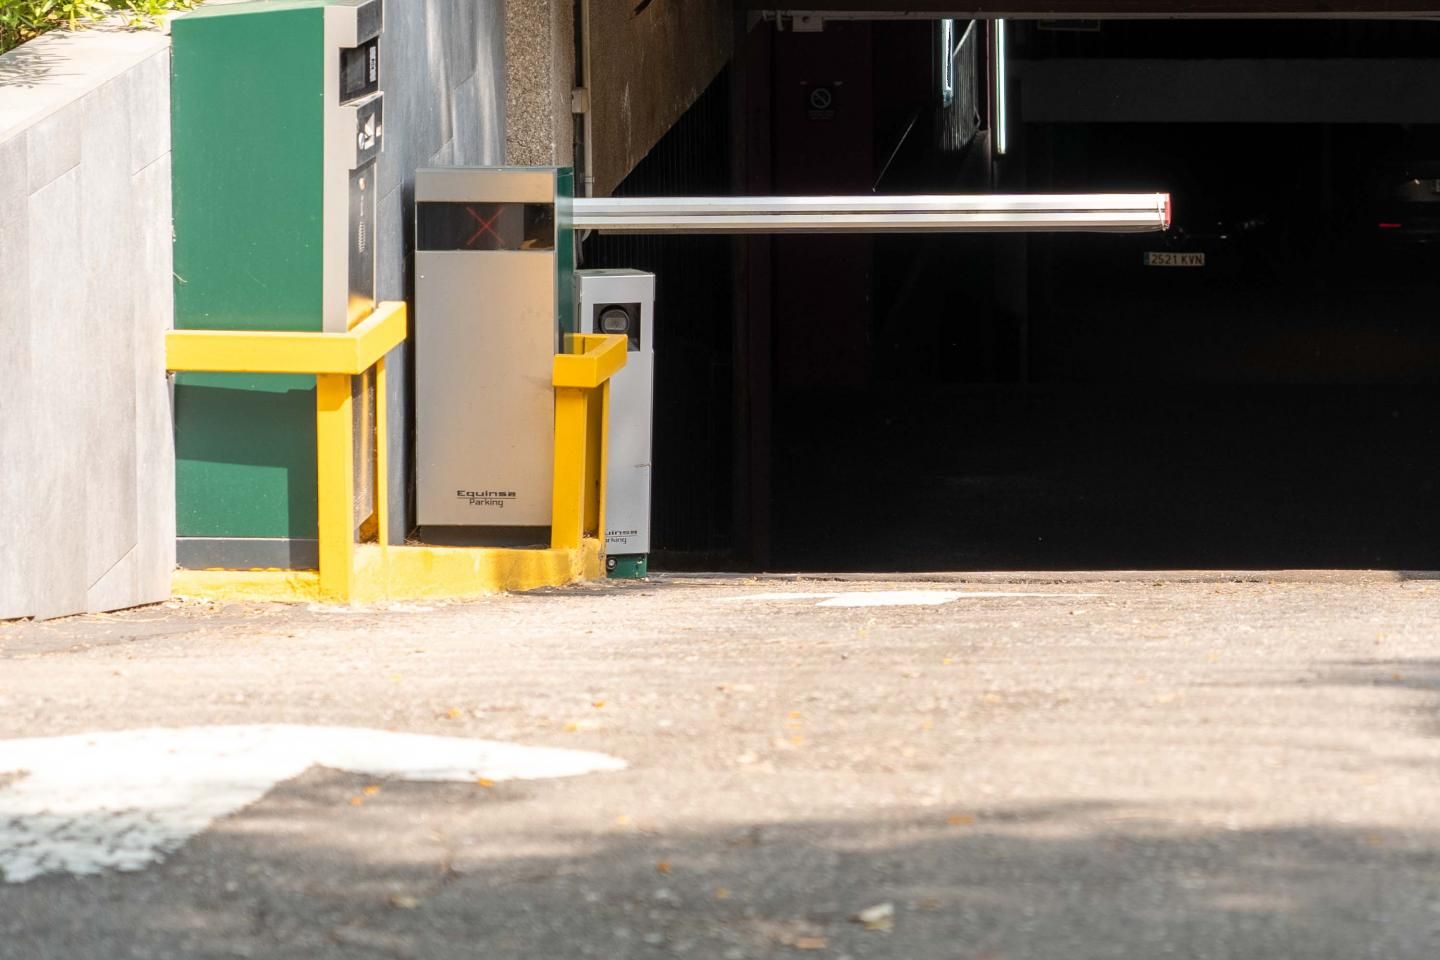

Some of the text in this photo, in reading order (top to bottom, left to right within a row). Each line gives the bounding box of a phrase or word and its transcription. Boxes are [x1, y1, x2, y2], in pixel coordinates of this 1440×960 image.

[1151, 254, 1202, 264] 2521 KVN
[469, 498, 504, 508] Parking
